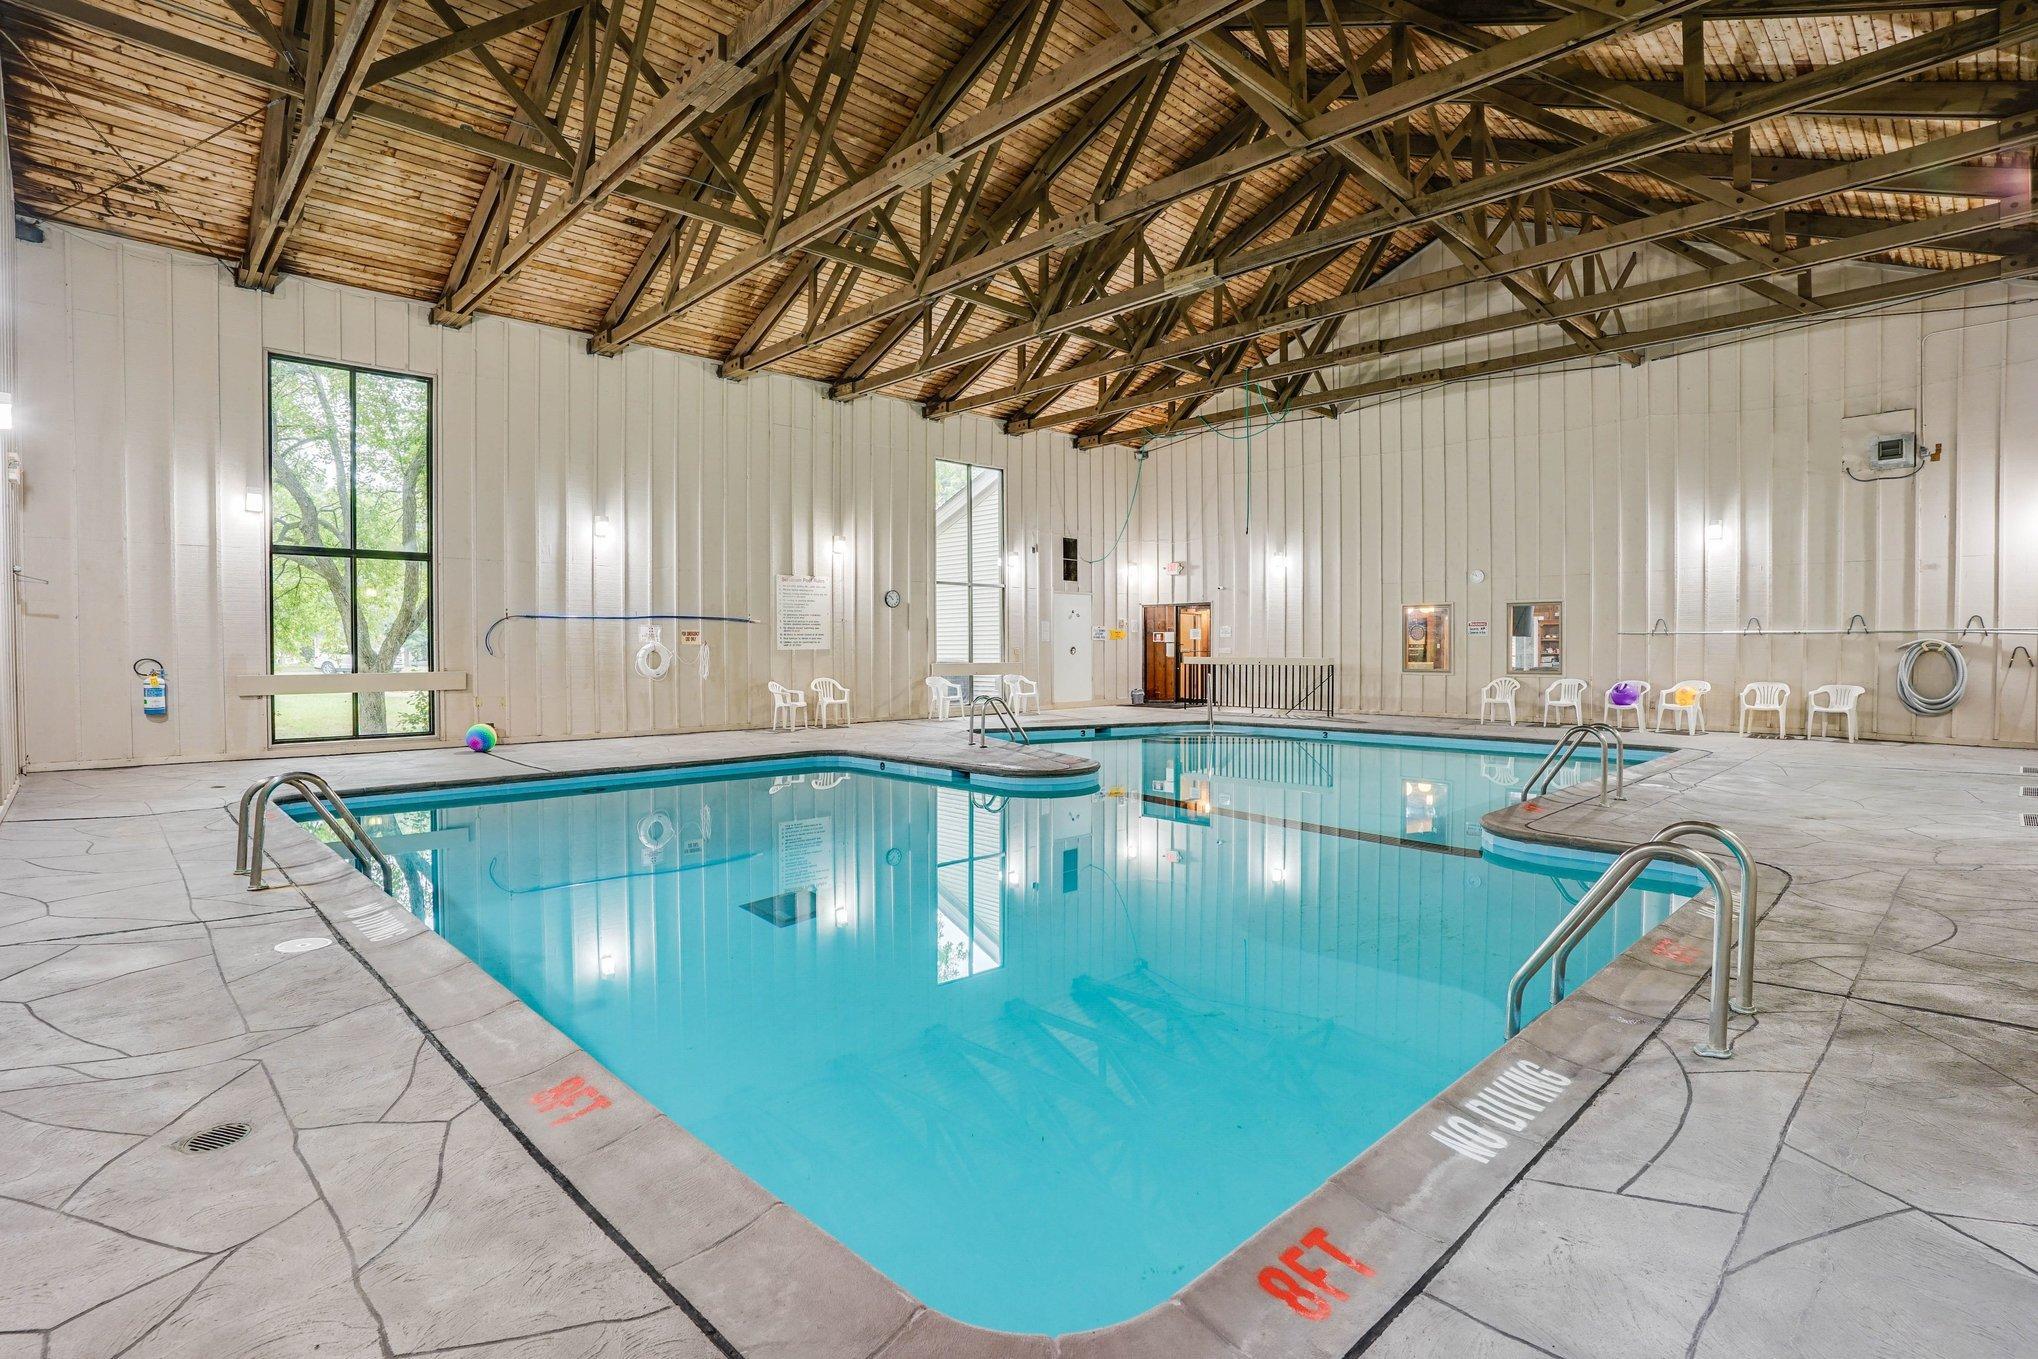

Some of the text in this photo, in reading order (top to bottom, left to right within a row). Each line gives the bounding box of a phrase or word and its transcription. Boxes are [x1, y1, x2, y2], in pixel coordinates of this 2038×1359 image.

[530, 1075, 613, 1129] 8FT
[1428, 1059, 1571, 1165] NO DIVING
[1256, 1226, 1377, 1322] 8FT
